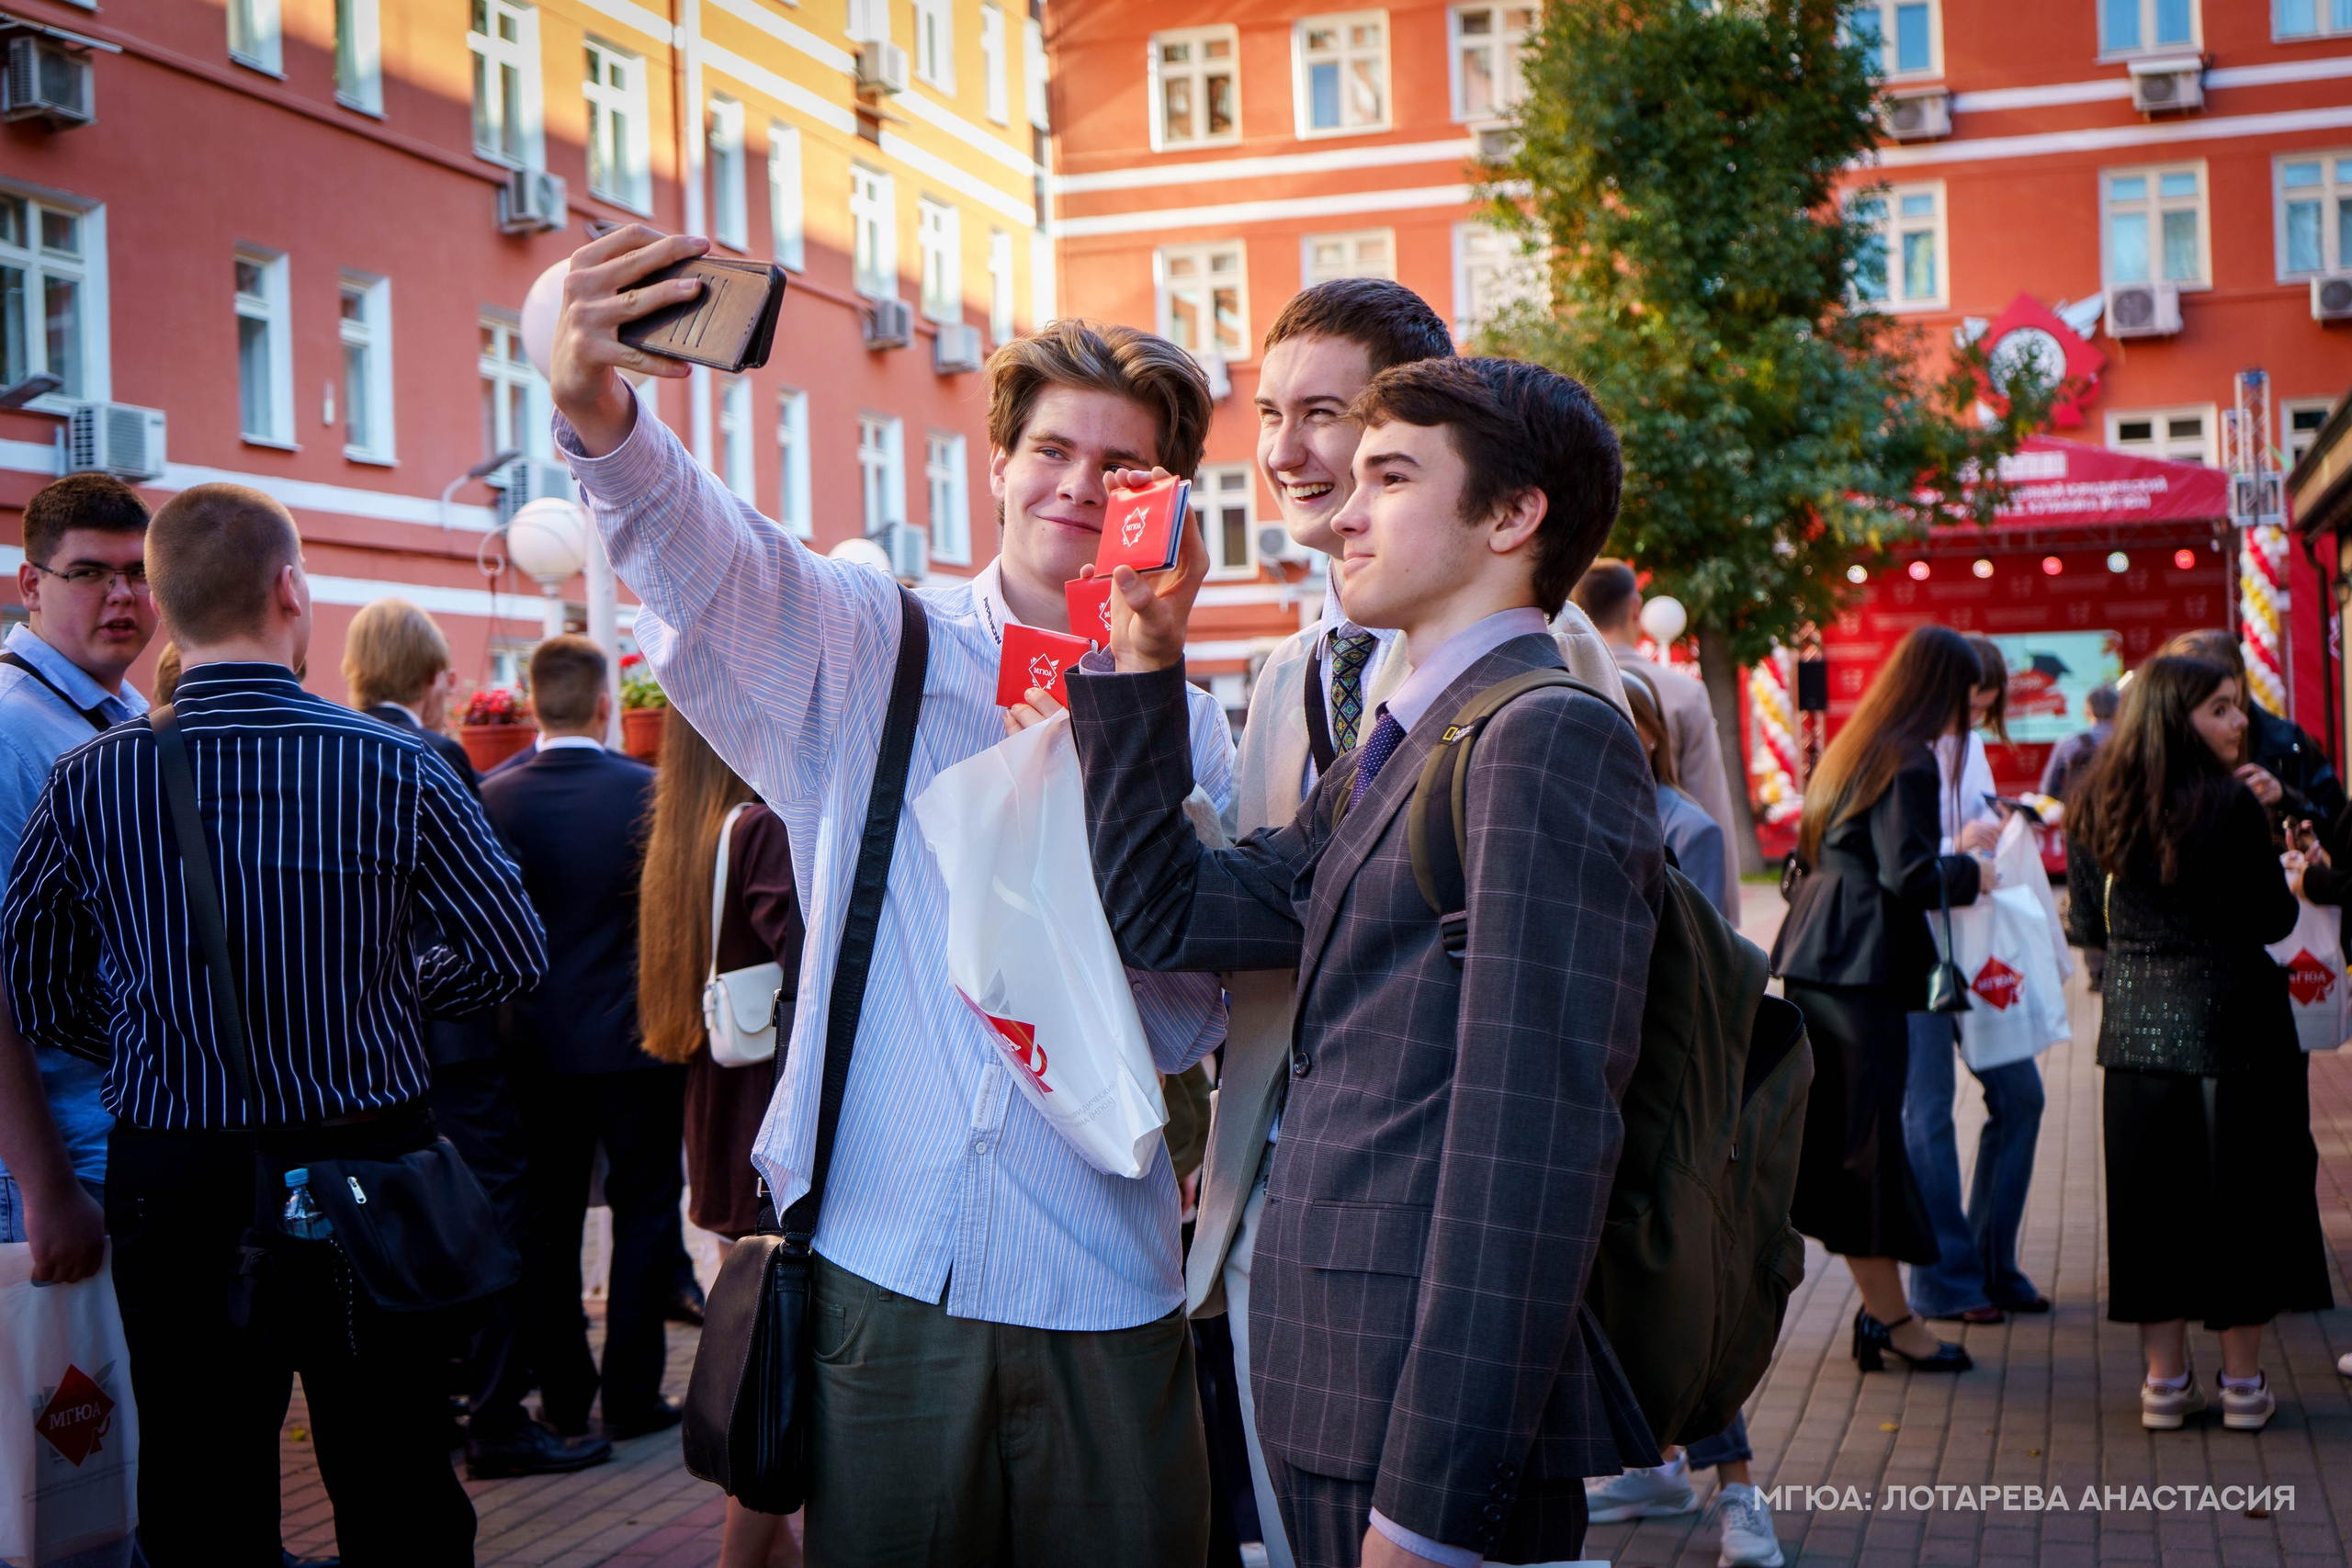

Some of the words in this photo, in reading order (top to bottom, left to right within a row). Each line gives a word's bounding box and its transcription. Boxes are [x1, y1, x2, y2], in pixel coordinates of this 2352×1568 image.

[1125, 522, 1141, 532] МГЮА
[1034, 667, 1053, 678] МГЮА
[1976, 973, 2017, 992] МГЮА
[1090, 1097, 1117, 1121] (МГЮА)
[49, 1401, 102, 1430] МГЮА
